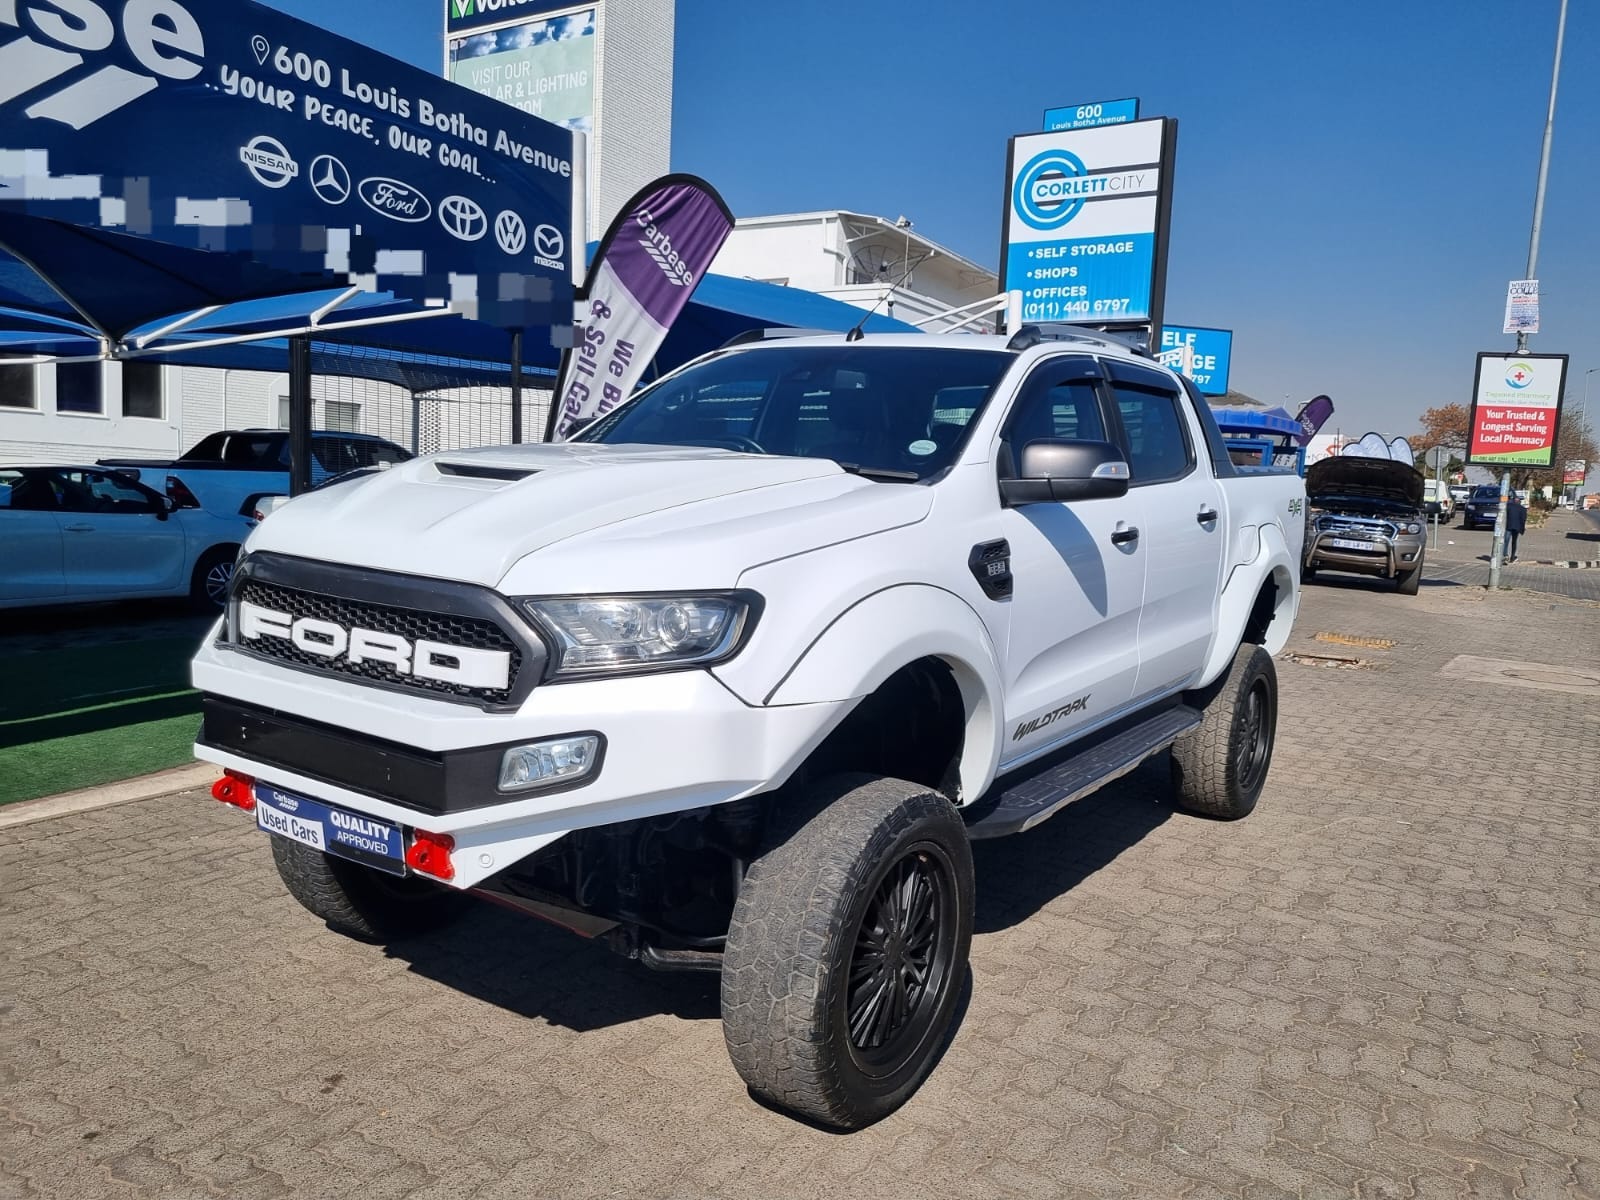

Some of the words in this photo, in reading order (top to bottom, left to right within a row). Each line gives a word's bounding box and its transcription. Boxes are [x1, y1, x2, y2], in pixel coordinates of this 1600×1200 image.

[472, 65, 503, 85] VISIT
[504, 60, 531, 80] OUR
[515, 82, 525, 97] &
[527, 70, 588, 96] LIGHTING
[274, 46, 331, 88] 600
[341, 68, 411, 118] Louis
[419, 98, 488, 147] Botha
[494, 130, 571, 177] Avenue
[1051, 122, 1071, 130] Louis
[1073, 118, 1096, 128] Botha
[1097, 115, 1127, 125] Avenue
[1076, 104, 1102, 119] 600
[305, 94, 380, 146] PEACE,
[388, 125, 432, 158] OUR
[244, 150, 296, 174] NISSAN
[1035, 178, 1108, 198] CORLETT
[1108, 174, 1145, 191] CITY
[372, 183, 418, 215] Ford
[635, 209, 694, 286] Carbase
[1035, 246, 1067, 259] SELF
[1070, 241, 1134, 256] STORAGE
[534, 256, 564, 271] mazda
[1034, 266, 1078, 279] SHOPS
[1033, 286, 1087, 298] OFFICES
[592, 299, 611, 320] &
[1024, 302, 1059, 317] (011)
[1063, 300, 1089, 313] 440
[1094, 299, 1130, 312] 6797
[1162, 331, 1197, 347] ELF
[576, 325, 606, 378] Sell
[608, 338, 635, 378] We
[1192, 375, 1211, 384] 797
[592, 382, 622, 418] Bu
[1486, 409, 1504, 419] Your
[1506, 410, 1537, 420] Trusted
[1538, 411, 1545, 420] &
[1481, 421, 1513, 432] Longest
[1516, 423, 1548, 435] Serving
[1480, 434, 1502, 443] Local
[1504, 434, 1545, 447] Pharmacy
[240, 600, 511, 690] FORD
[1012, 693, 1092, 741] WILDTRAK
[273, 791, 299, 808] Carbase
[261, 807, 288, 833] Used
[291, 818, 319, 844] Cars
[330, 811, 391, 841] QUALITY
[337, 830, 389, 855] APPROVED
